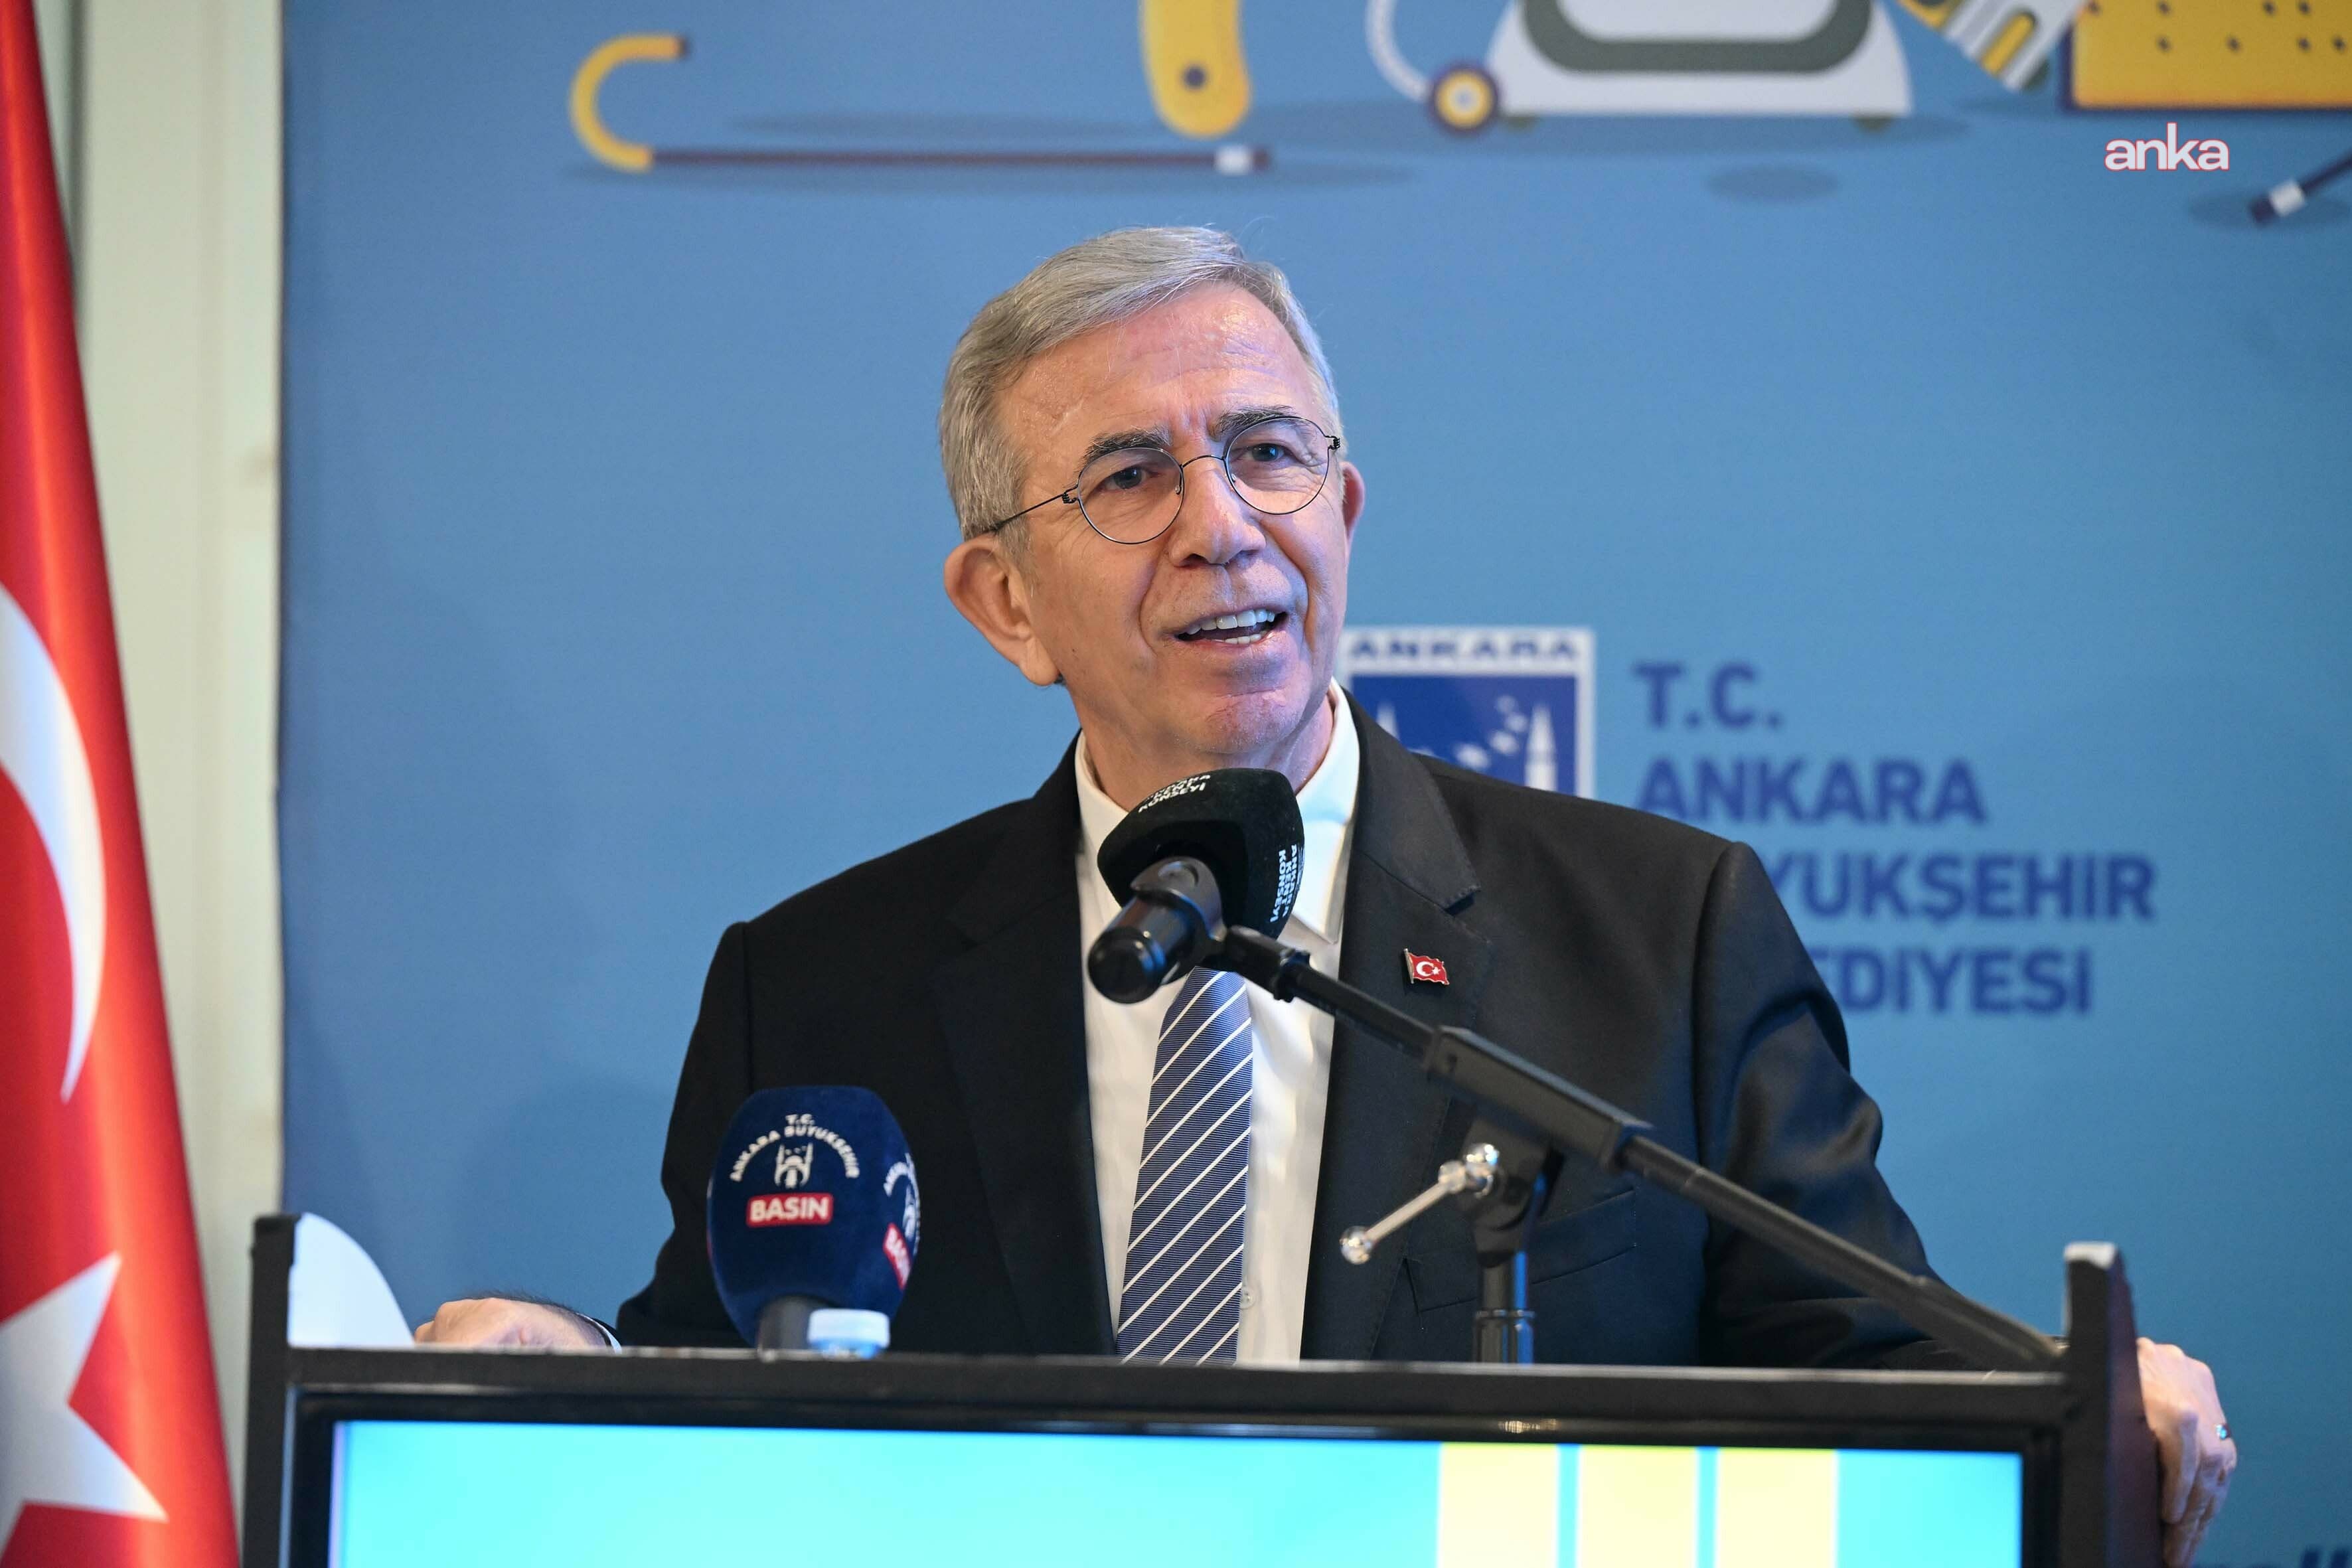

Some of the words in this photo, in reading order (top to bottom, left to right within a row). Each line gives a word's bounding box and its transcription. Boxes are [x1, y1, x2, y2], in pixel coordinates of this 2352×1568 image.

[1352, 639, 1577, 659] ANKARA
[1633, 662, 1784, 730] T.C.
[1636, 756, 1986, 824] ANKARA
[749, 1196, 830, 1223] BASIN
